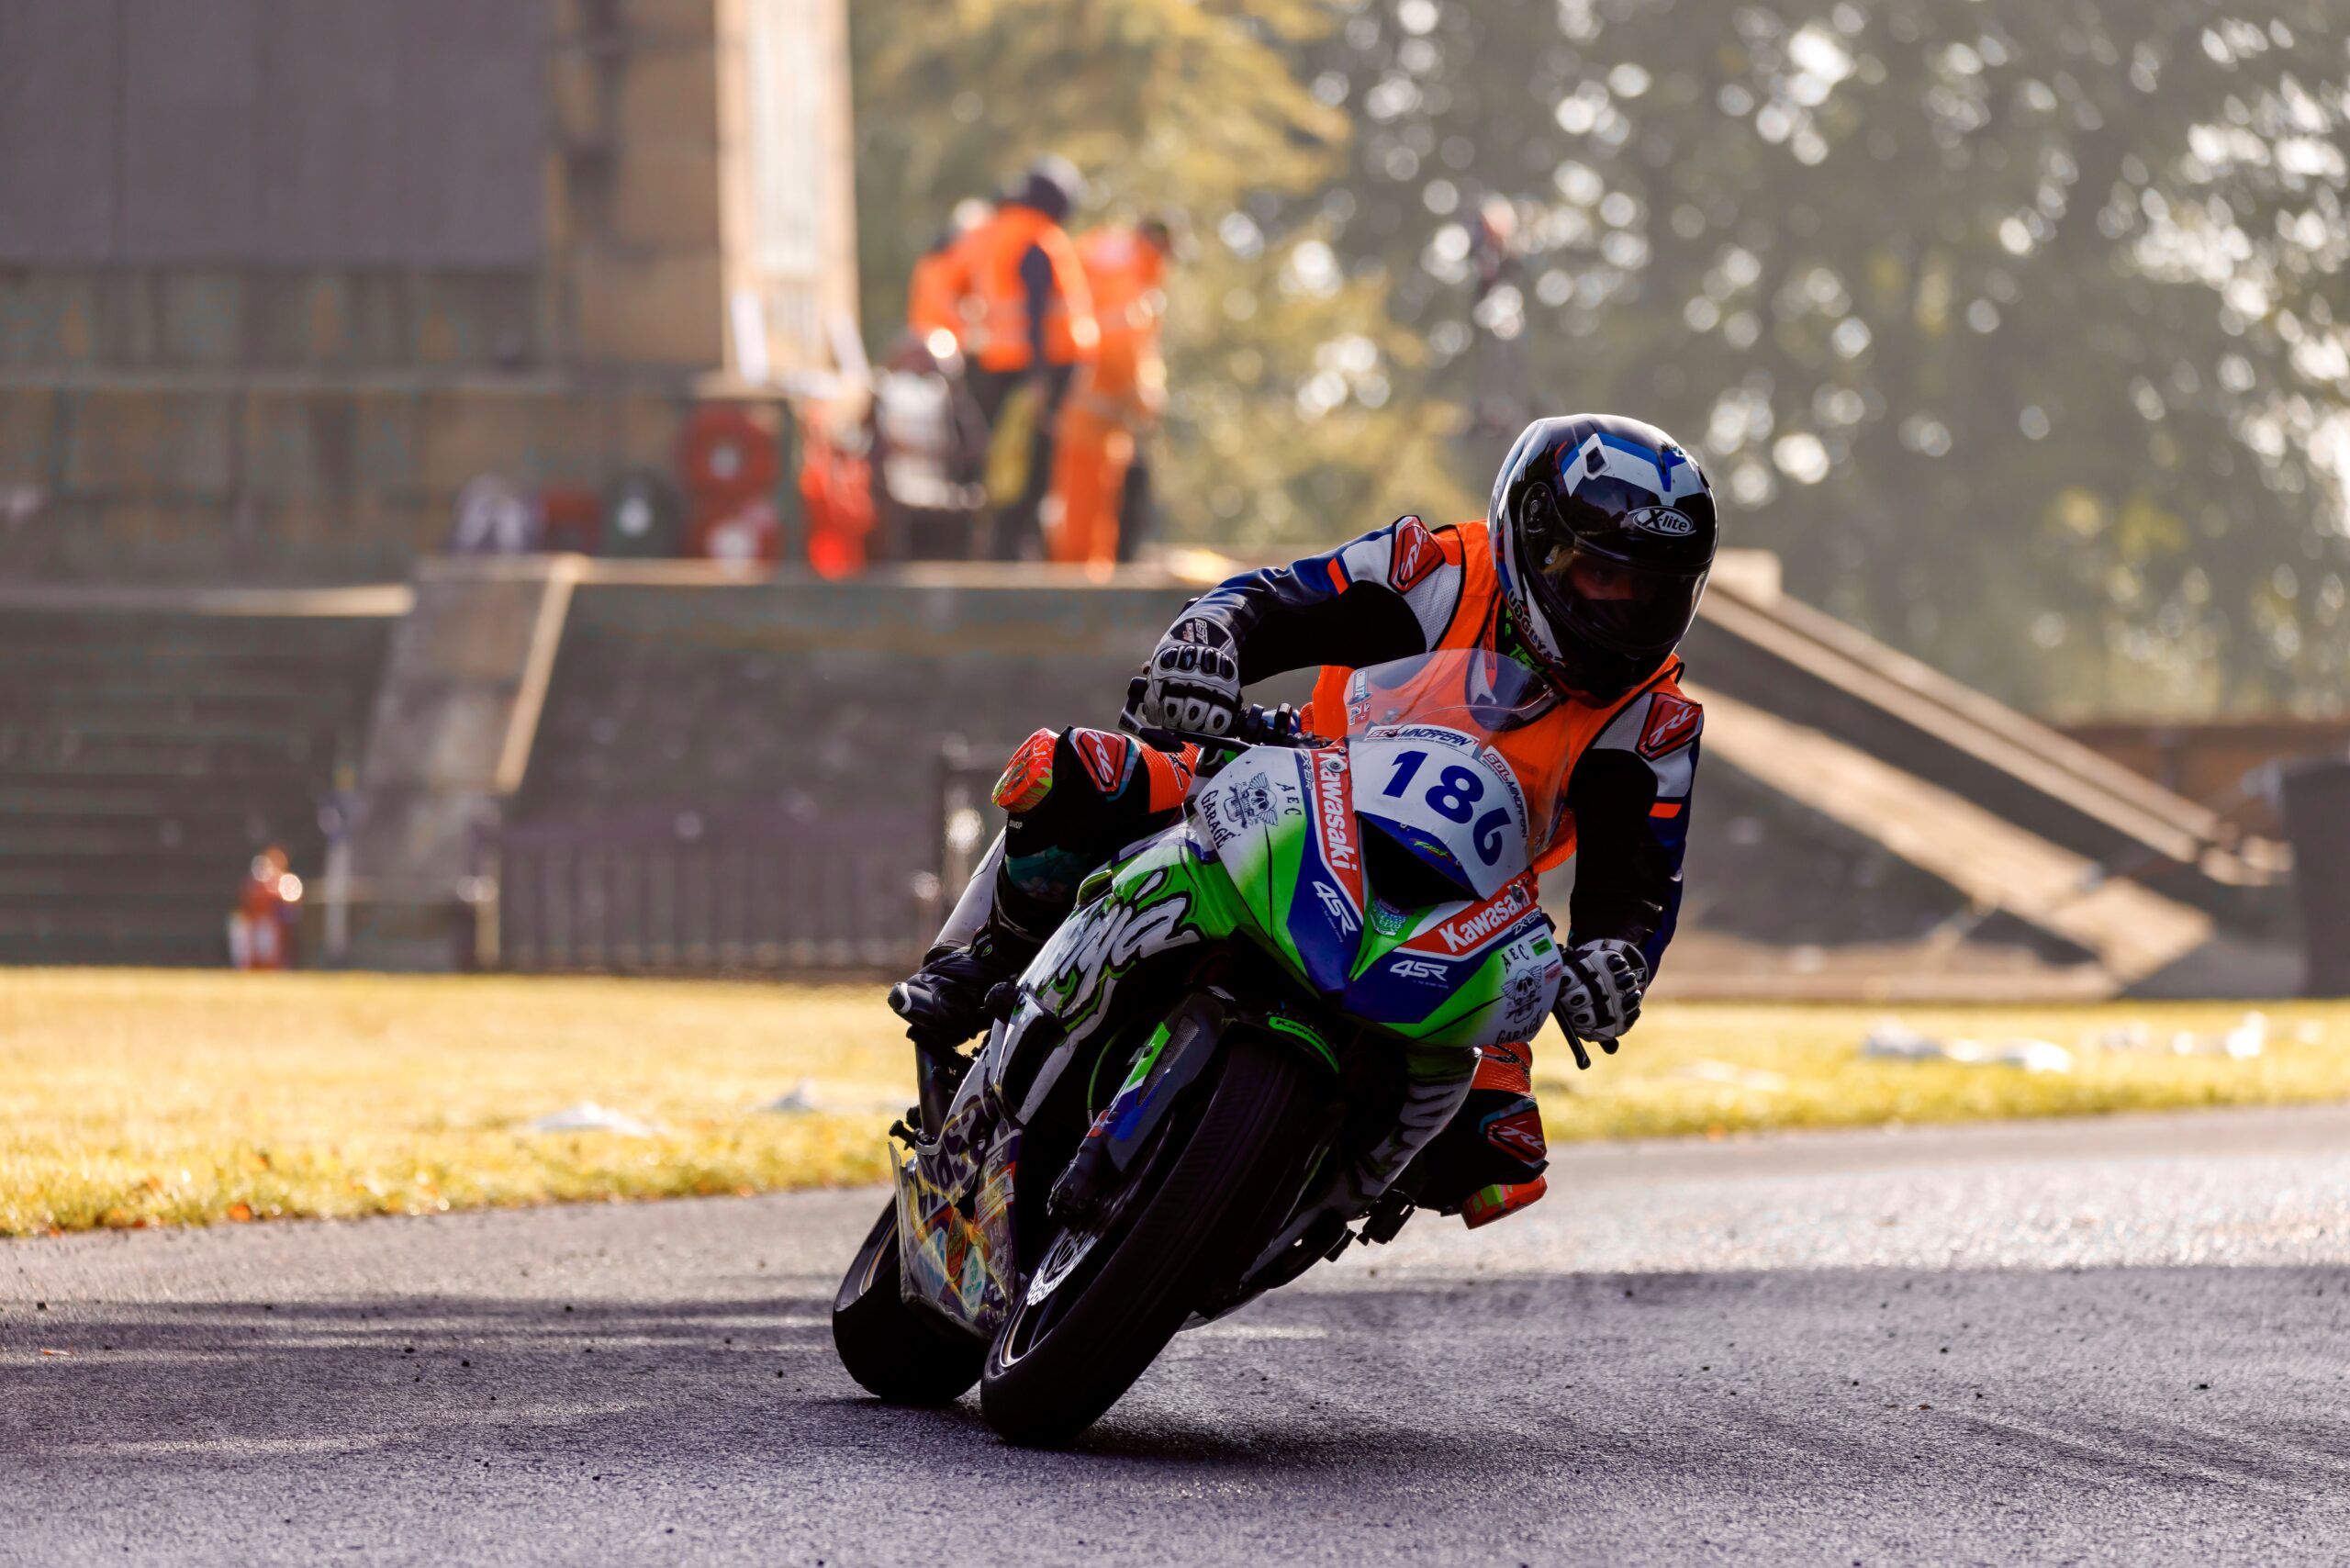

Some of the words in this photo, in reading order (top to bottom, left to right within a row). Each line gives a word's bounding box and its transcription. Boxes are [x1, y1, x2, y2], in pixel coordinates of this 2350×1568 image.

[1641, 509, 1689, 532] X-lite
[1201, 790, 1236, 850] GARAGE
[1315, 751, 1359, 871] Kawasaki
[1382, 749, 1513, 868] 186
[1275, 1018, 1339, 1065] Kawas
[1495, 1009, 1543, 1045] GARAGE
